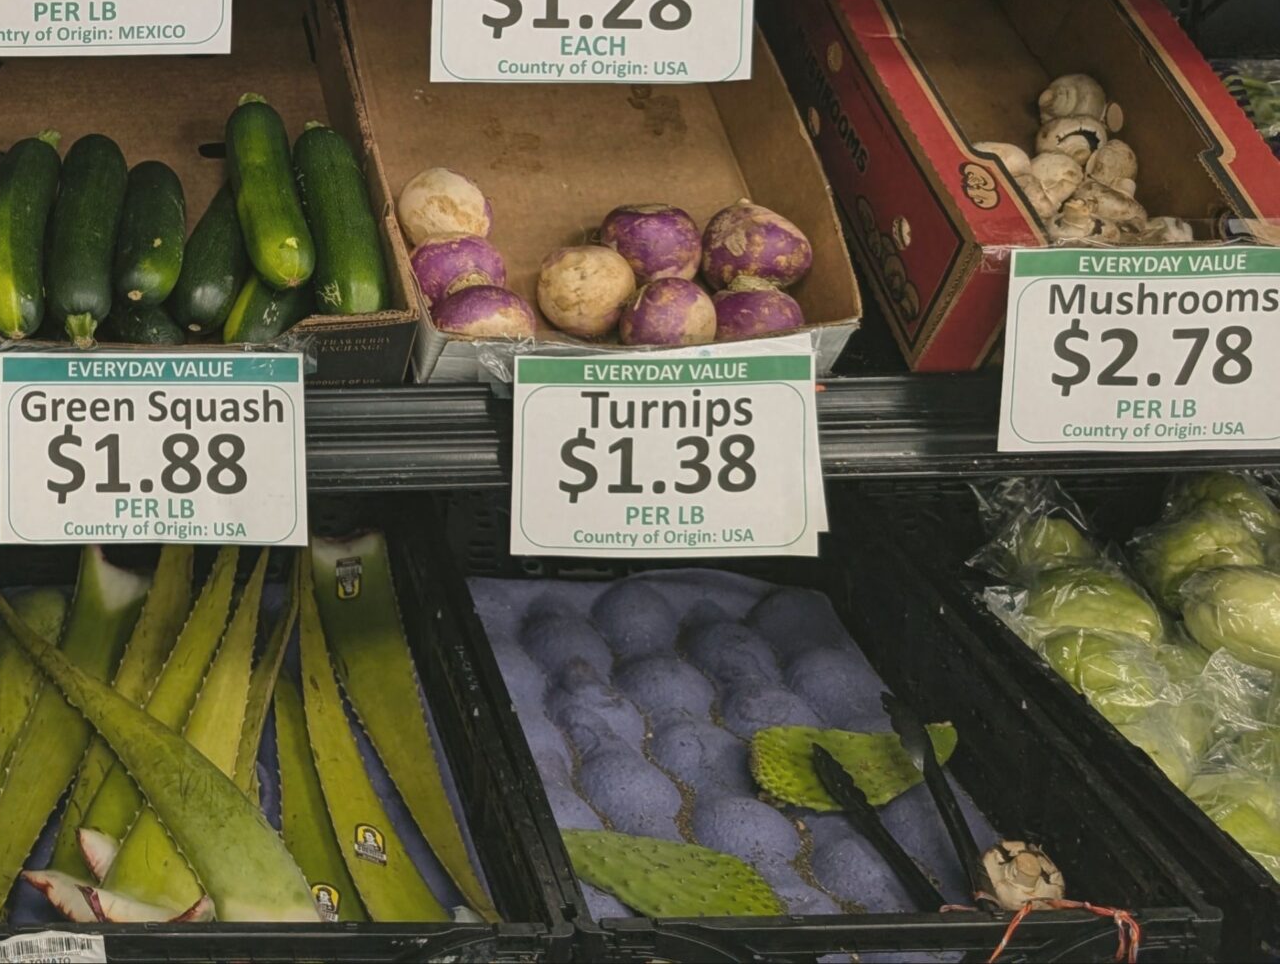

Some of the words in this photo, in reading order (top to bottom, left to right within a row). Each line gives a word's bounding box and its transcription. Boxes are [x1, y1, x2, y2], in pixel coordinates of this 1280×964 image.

[34, 2, 80, 22] PER
[89, 1, 117, 21] LB
[35, 27, 53, 41] of
[57, 26, 113, 44] Origin:
[119, 25, 186, 40] MEXICO
[560, 35, 626, 56] EACH
[497, 59, 563, 79] Country
[568, 59, 588, 75] of
[592, 60, 649, 79] Origin:
[653, 61, 688, 76] USA
[1079, 255, 1183, 274] EVERYDAY
[1187, 253, 1247, 271] VALUE
[1048, 282, 1279, 315] Mushrooms
[321, 337, 391, 346] TRAWBERRY
[1051, 318, 1253, 397] $2.78
[68, 361, 167, 377] EVERYDAY
[171, 361, 233, 377] VALUE
[583, 364, 684, 381] EVERYDAY
[688, 362, 748, 379] VALUE
[20, 390, 135, 423] Green
[148, 390, 285, 429] Squash
[581, 389, 753, 436] Turnips
[1117, 400, 1162, 419] PER
[1170, 399, 1196, 418] LB
[1063, 423, 1129, 440] Country
[1132, 422, 1151, 437] of
[1154, 422, 1207, 439] Origin:
[1212, 421, 1245, 435] USA
[46, 424, 247, 504] $1.88
[558, 427, 756, 504] $1.38
[115, 499, 160, 519] PER
[168, 499, 195, 519] LB
[625, 506, 670, 525] PER
[678, 506, 705, 525] LB
[64, 521, 128, 539] Country
[132, 521, 149, 536] of
[154, 522, 208, 539] Origin:
[213, 523, 247, 537] USA
[573, 530, 639, 547] Country
[642, 529, 660, 544] of
[664, 529, 717, 547] Origin:
[722, 529, 754, 543] USA
